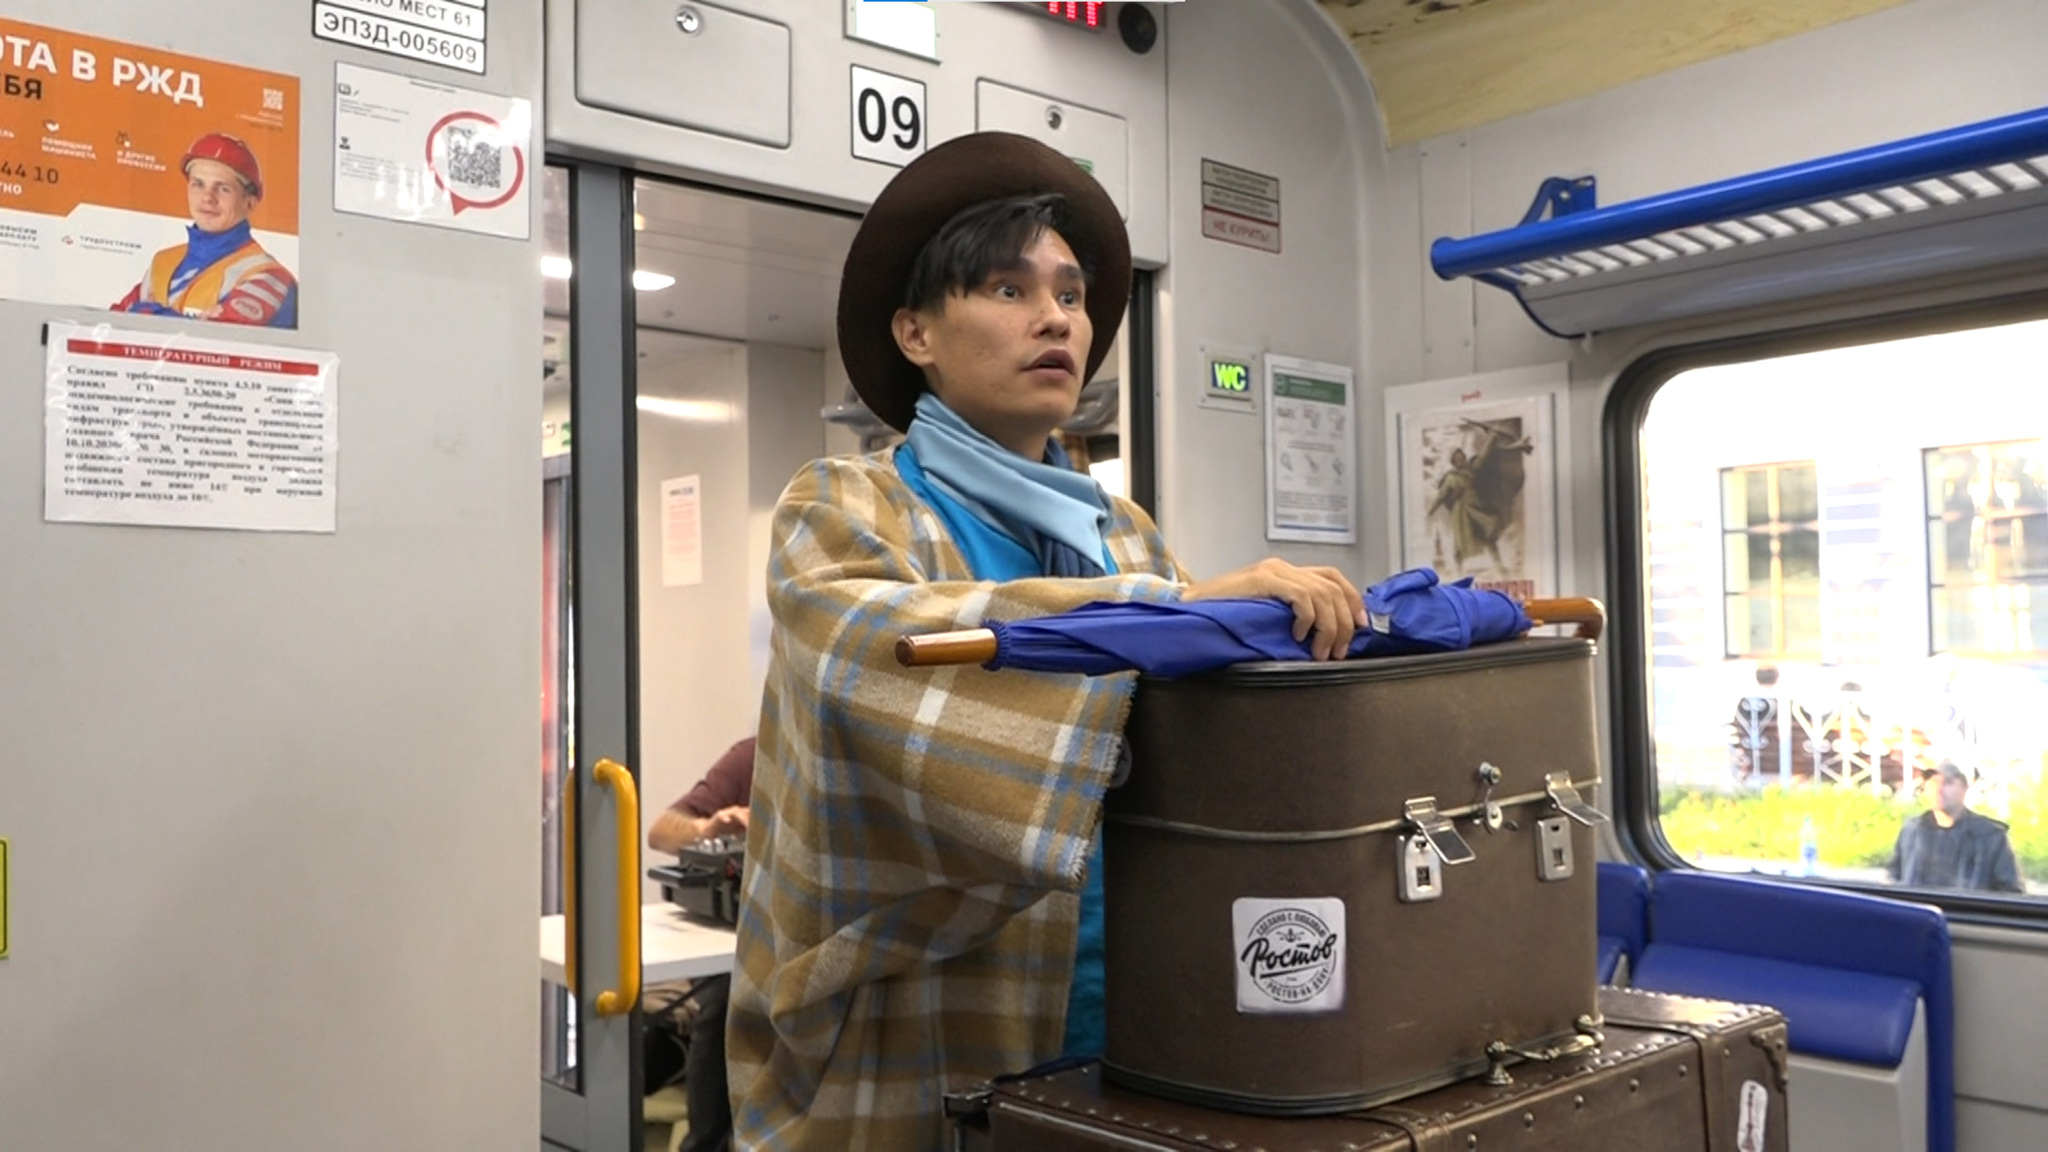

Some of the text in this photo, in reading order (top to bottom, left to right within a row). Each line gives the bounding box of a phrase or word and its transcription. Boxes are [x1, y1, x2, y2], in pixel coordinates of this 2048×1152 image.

[399, 0, 447, 21] МЕСТ
[453, 12, 472, 27] 61
[0, 34, 204, 108] ТА В РЖД
[0, 74, 42, 100] БЯ
[858, 88, 921, 150] 09
[34, 166, 59, 184] 10
[240, 358, 282, 372] РЕЖИМ
[1213, 362, 1247, 392] WC
[1240, 933, 1337, 978] Ростов
